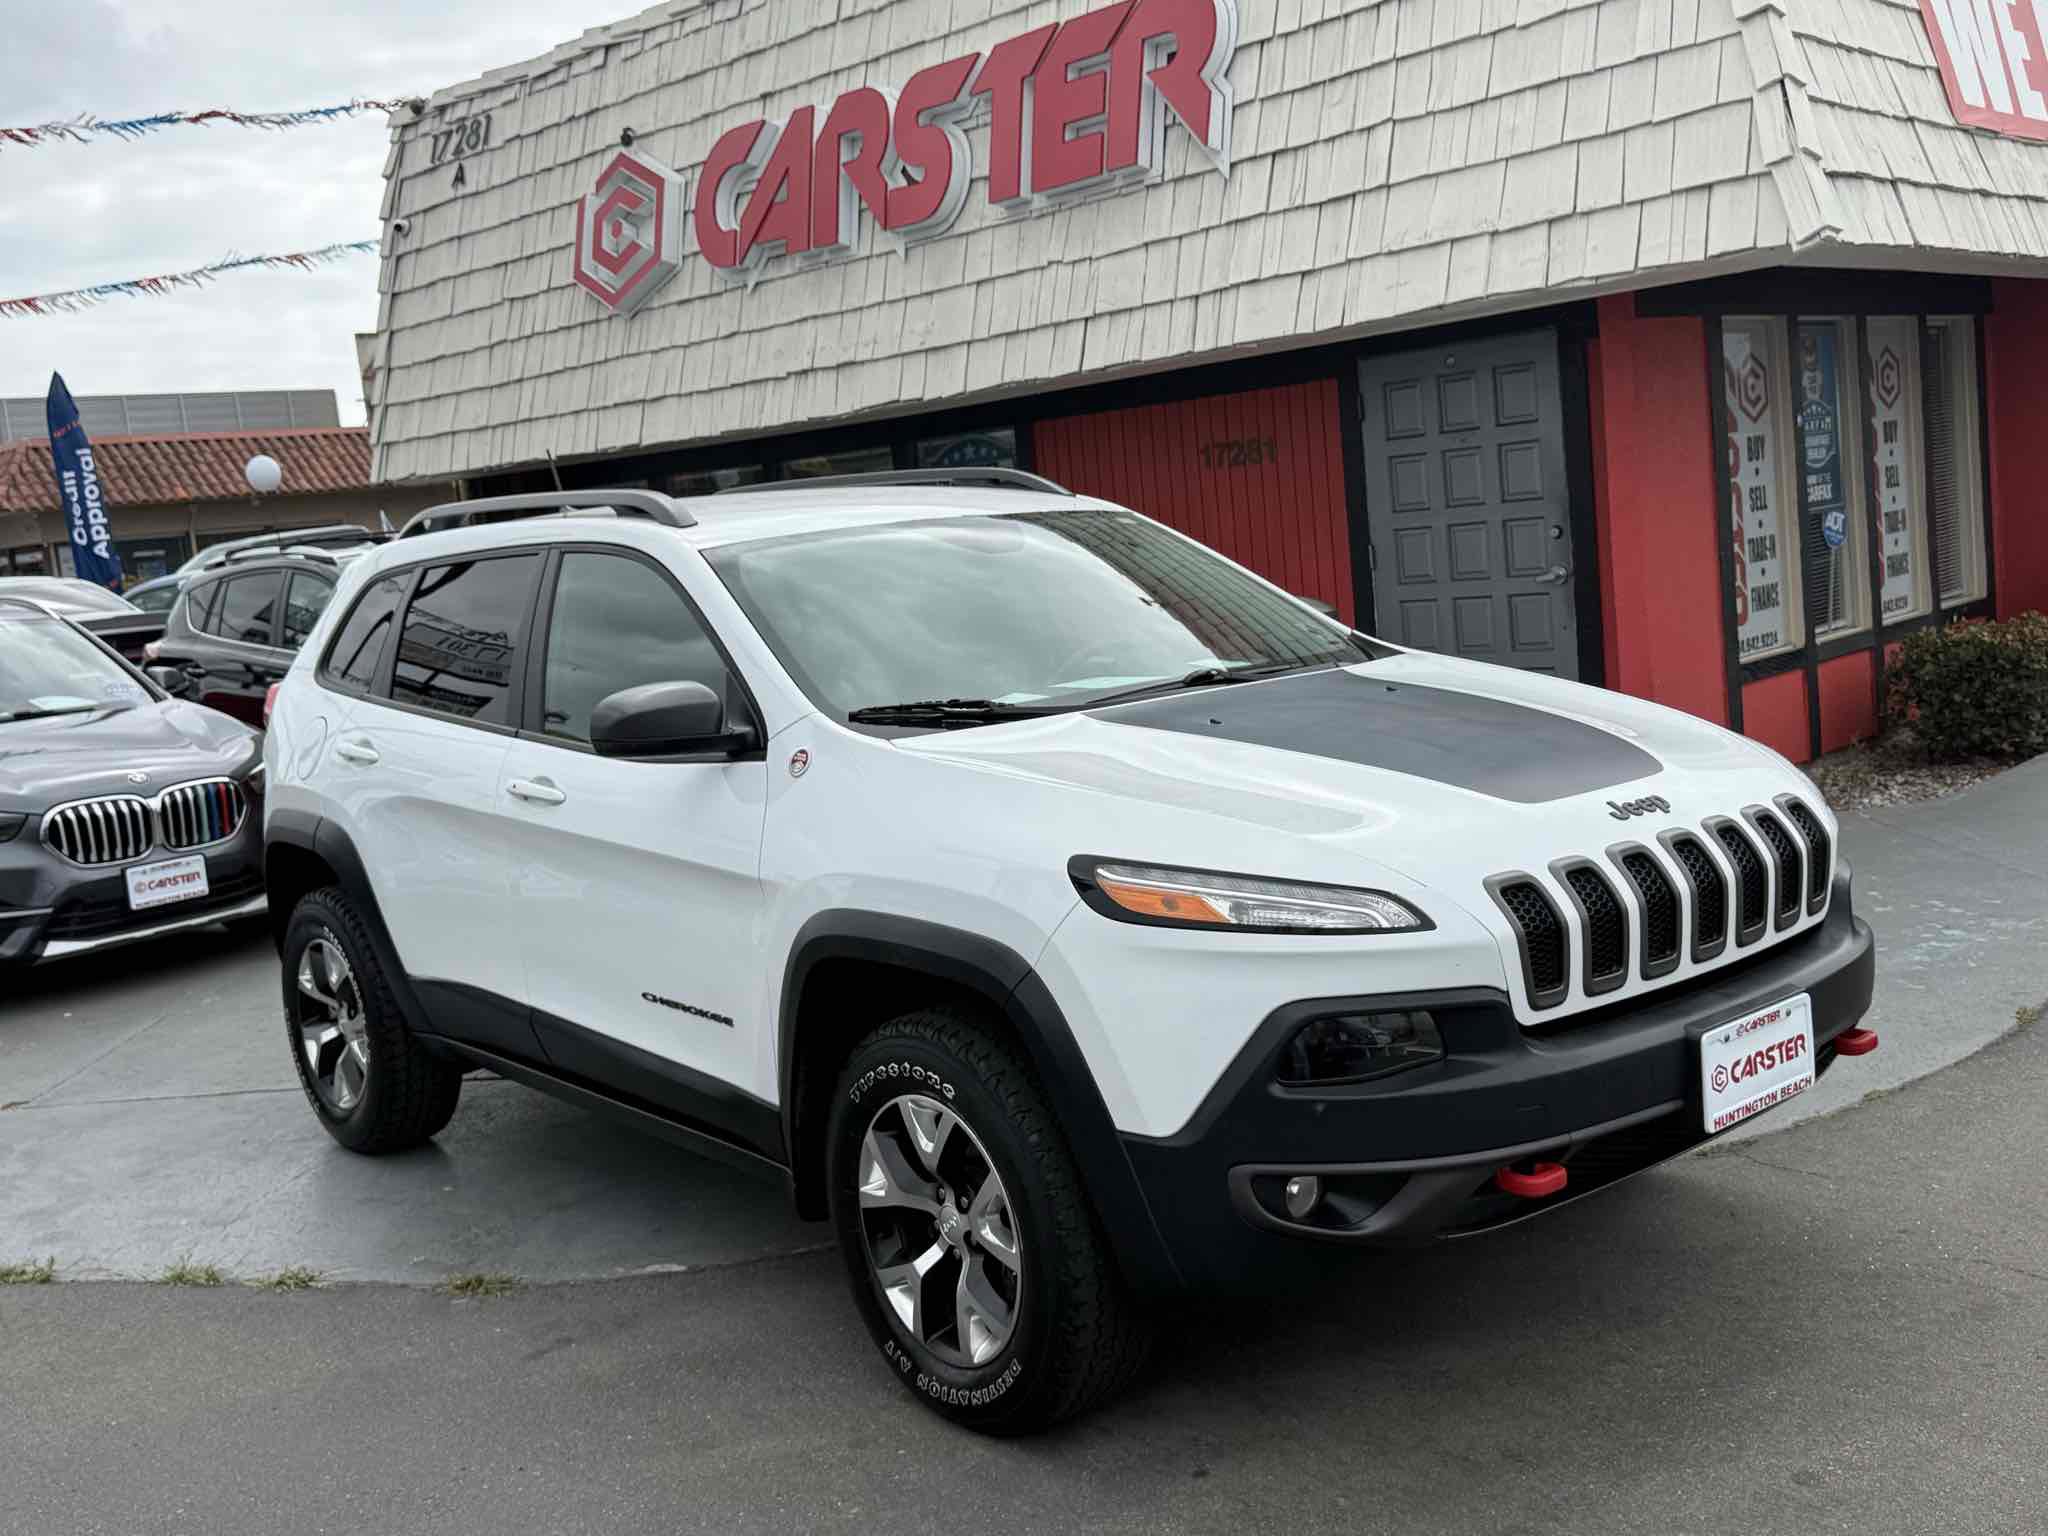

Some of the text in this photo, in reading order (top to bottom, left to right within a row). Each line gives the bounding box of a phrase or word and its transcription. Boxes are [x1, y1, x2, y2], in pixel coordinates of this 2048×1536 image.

[430, 114, 492, 164] 17281
[694, 0, 1216, 268] CARSTER
[451, 163, 466, 189] A
[1746, 434, 1765, 462] BUY
[1885, 465, 1900, 489] SELL
[62, 469, 88, 547] Credit
[75, 447, 111, 560] Approval
[1748, 485, 1768, 512] SELL
[1825, 511, 1846, 533] ADT
[1750, 581, 1780, 613] FINANCE
[1606, 794, 1671, 821] Jeep
[148, 871, 202, 891] CARSTER
[641, 991, 735, 1029] CHEROKEE
[1744, 1009, 1781, 1033] CARSTER
[1731, 1033, 1807, 1084] CARSTER
[849, 1061, 956, 1104] Firestone
[1713, 1076, 1813, 1129] HUNTINGTON BEACH
[916, 1357, 1023, 1407] DESTINATION
